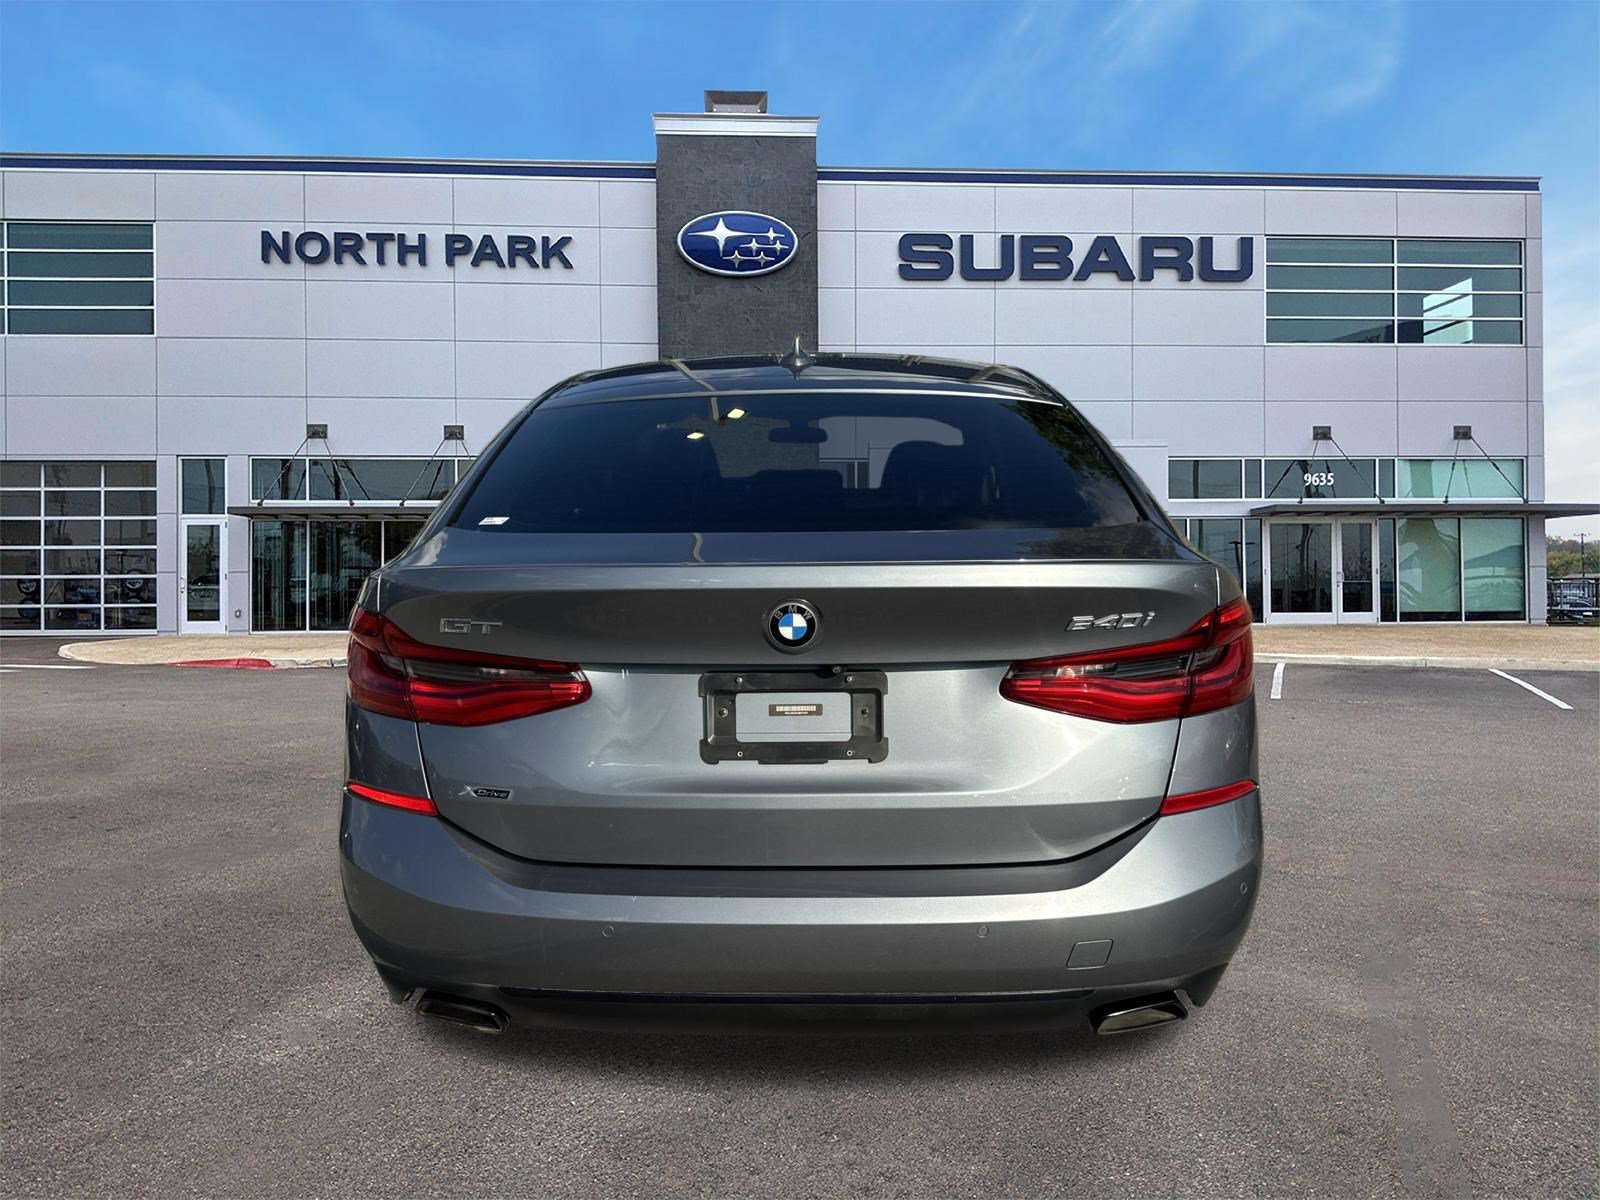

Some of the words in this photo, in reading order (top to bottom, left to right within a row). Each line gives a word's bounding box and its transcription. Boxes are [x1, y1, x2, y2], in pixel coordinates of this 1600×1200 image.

[261, 230, 427, 267] NORTH
[445, 233, 574, 269] PARK
[898, 233, 1254, 282] SUBARU
[1303, 472, 1335, 486] 9635
[440, 617, 503, 634] GT
